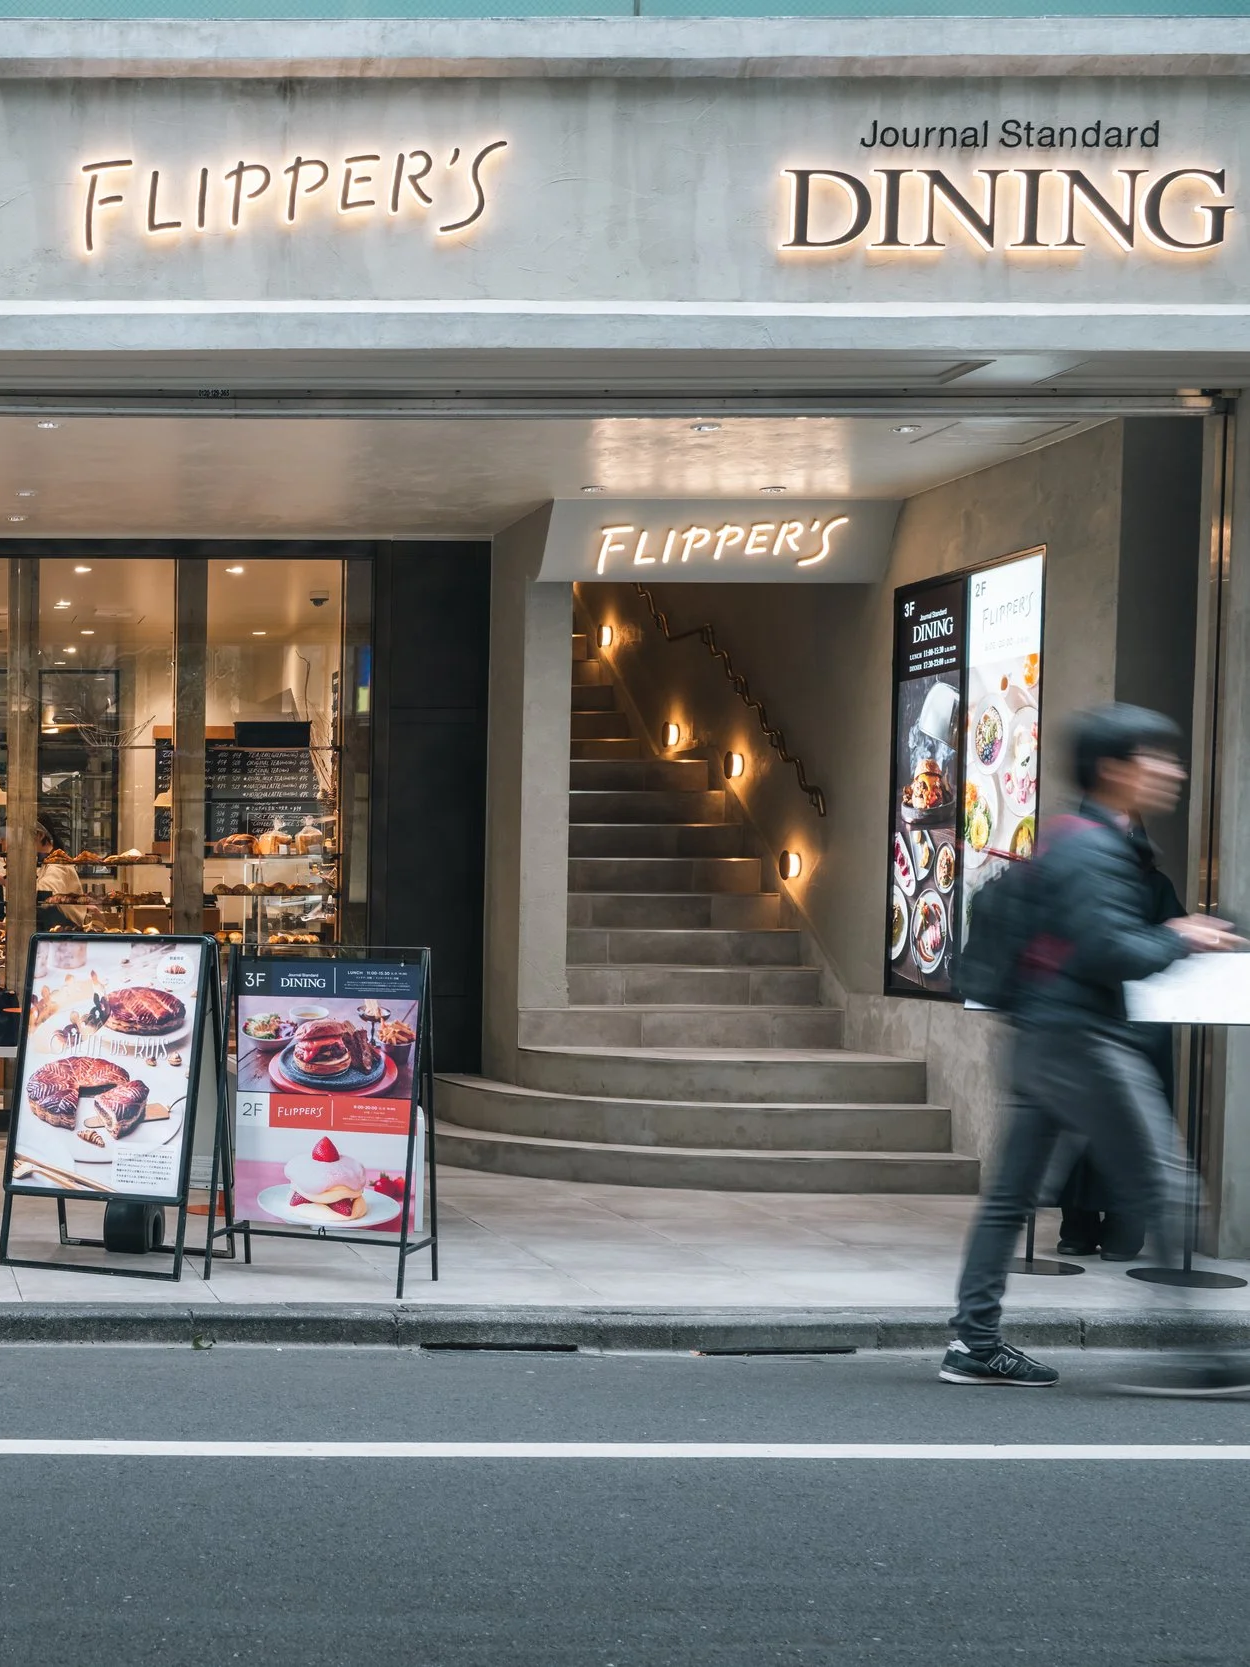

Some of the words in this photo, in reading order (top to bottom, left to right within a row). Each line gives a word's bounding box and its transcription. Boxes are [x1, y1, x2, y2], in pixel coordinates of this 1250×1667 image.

[860, 119, 988, 149] Journal
[999, 119, 1160, 148] Standard
[81, 139, 508, 253] FLIPPER'S
[780, 168, 1235, 251] DINING
[596, 515, 850, 576] FLIPPER'S
[975, 581, 987, 597] 2F
[904, 601, 916, 618] 3F
[981, 592, 1034, 634] FLIPPER'S
[912, 616, 954, 644] DINING
[244, 972, 266, 988] 3F
[280, 978, 326, 989] DINING
[242, 1102, 264, 1116] 2F
[277, 1105, 324, 1119] FLIPPER'S
